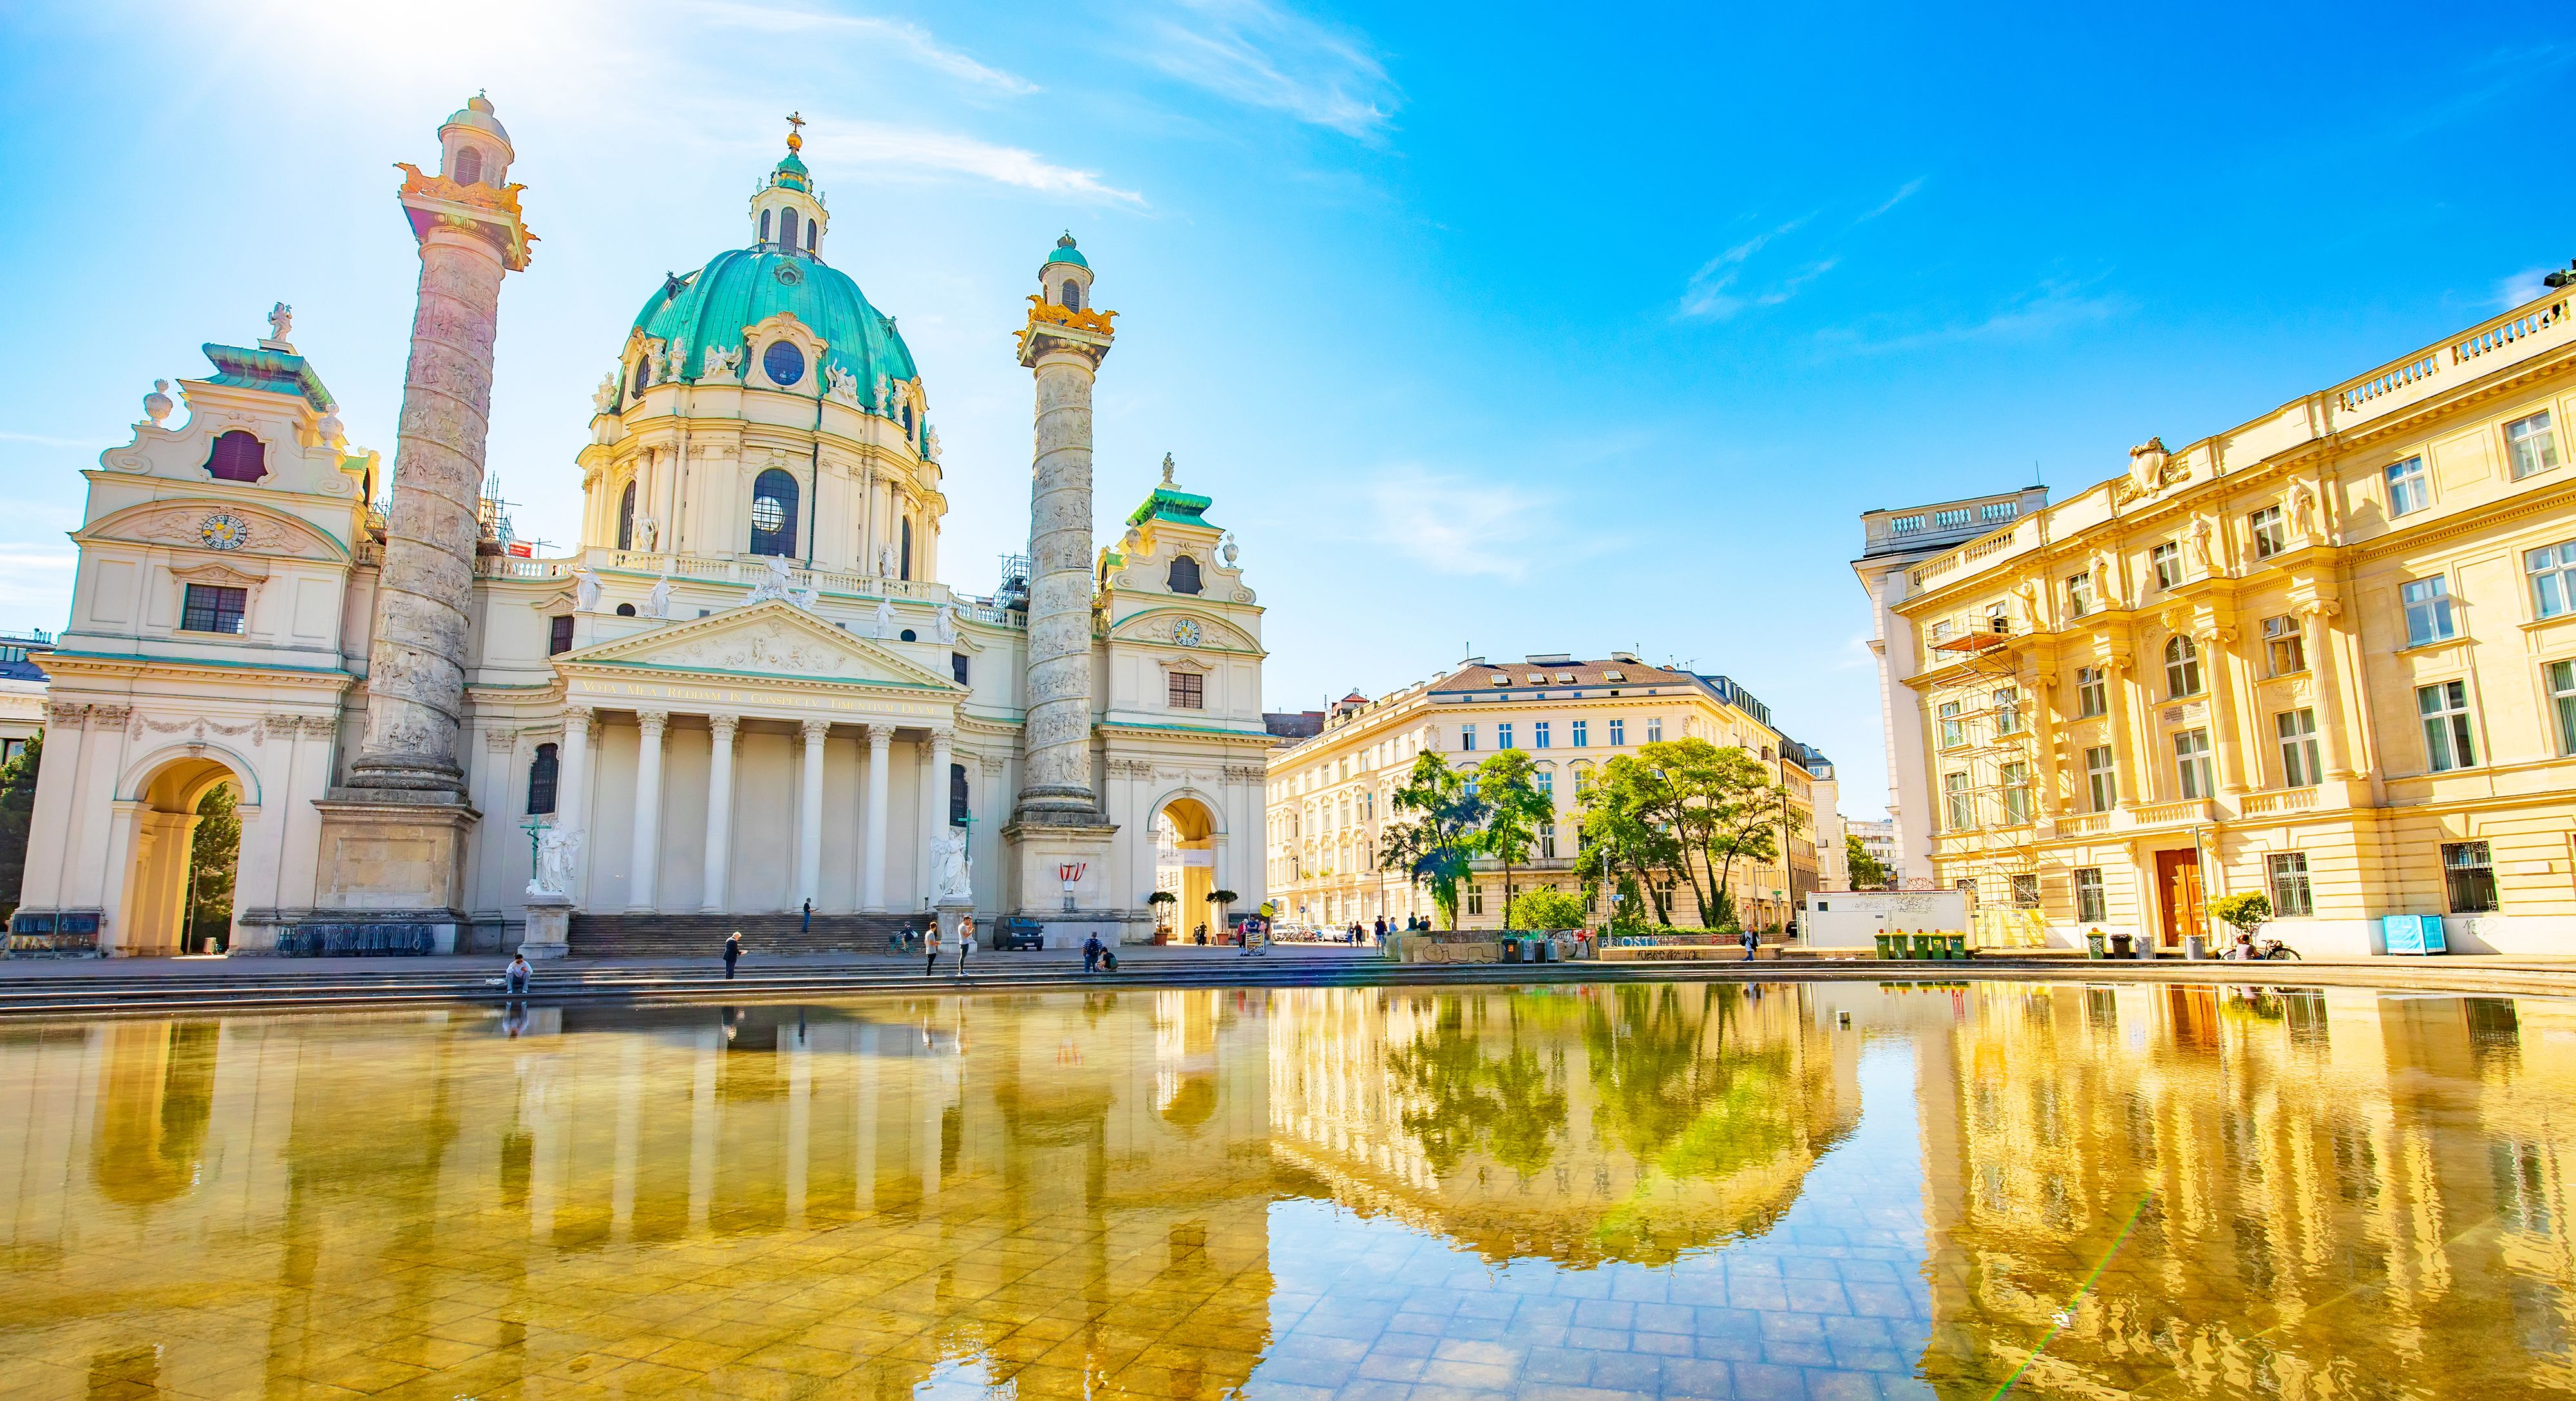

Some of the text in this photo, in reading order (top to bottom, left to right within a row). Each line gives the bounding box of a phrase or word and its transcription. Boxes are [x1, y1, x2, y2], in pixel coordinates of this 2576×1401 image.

[582, 681, 616, 694] VOTA
[627, 685, 657, 697] MEA
[667, 688, 721, 701] REDDAM
[730, 692, 741, 702] IN
